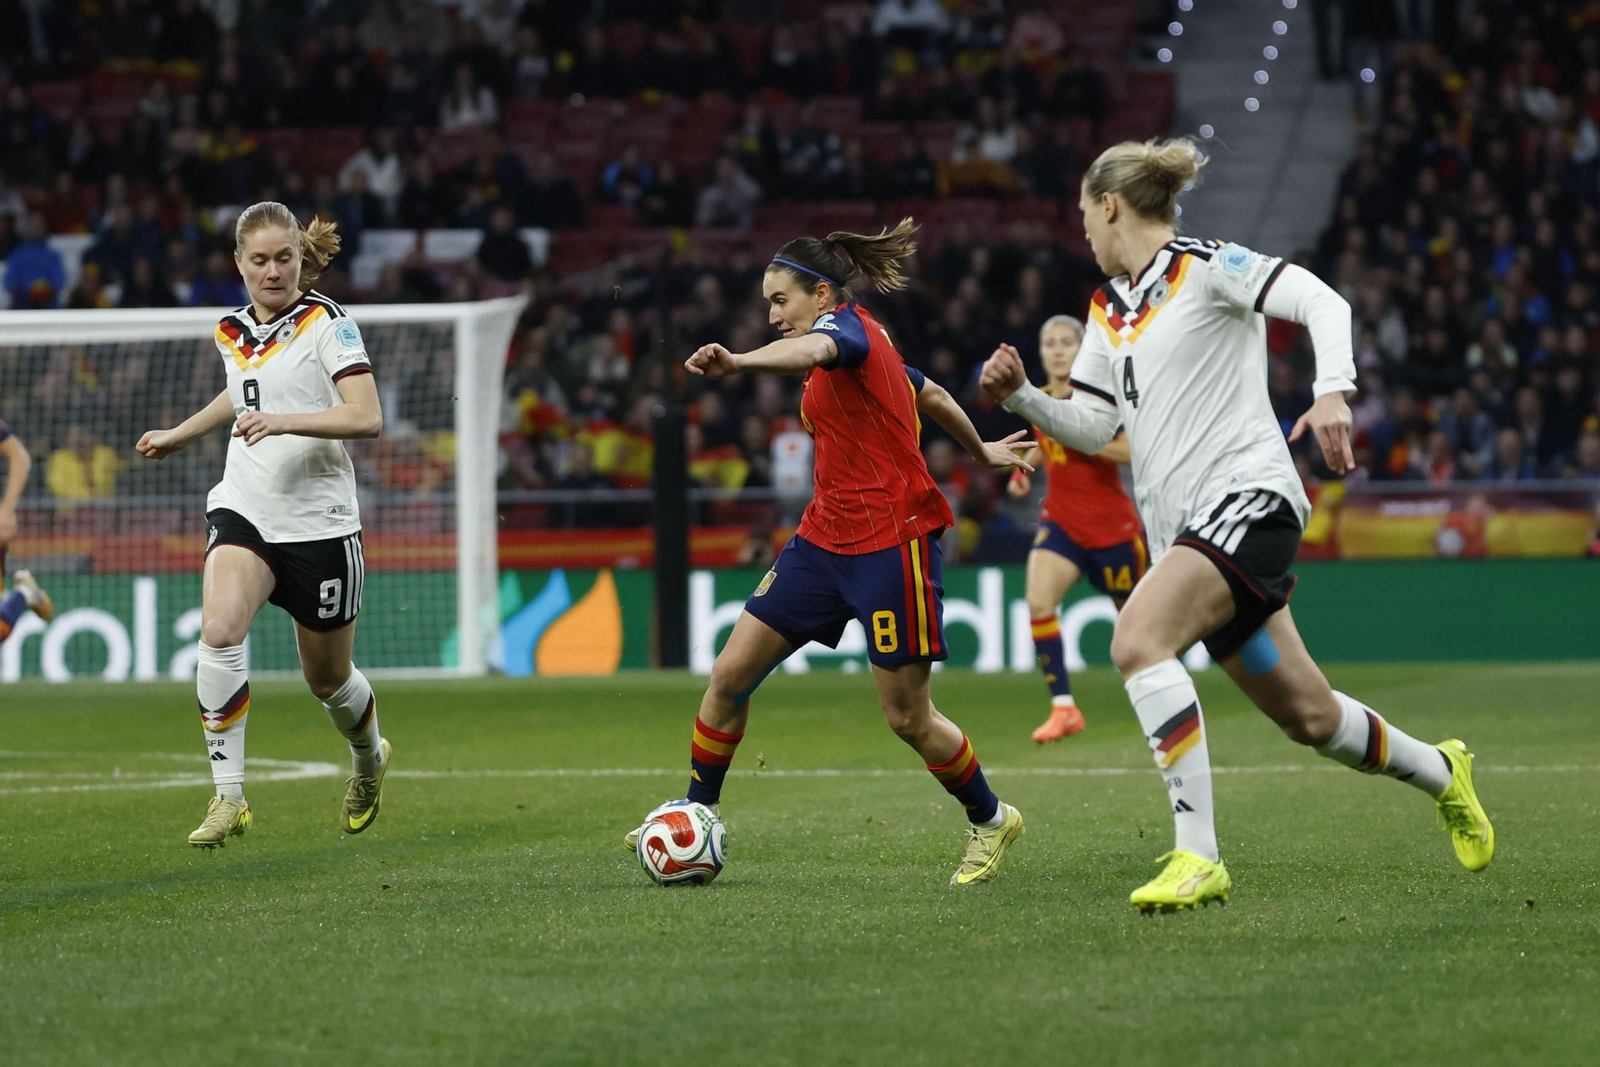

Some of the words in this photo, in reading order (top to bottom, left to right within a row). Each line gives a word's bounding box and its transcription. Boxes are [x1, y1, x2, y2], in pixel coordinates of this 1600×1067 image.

[243, 379, 260, 411] 9
[1123, 355, 1139, 409] 4
[1103, 565, 1133, 590] 14
[318, 578, 342, 619] 9
[872, 610, 898, 653] 8
[1167, 776, 1183, 790] FB
